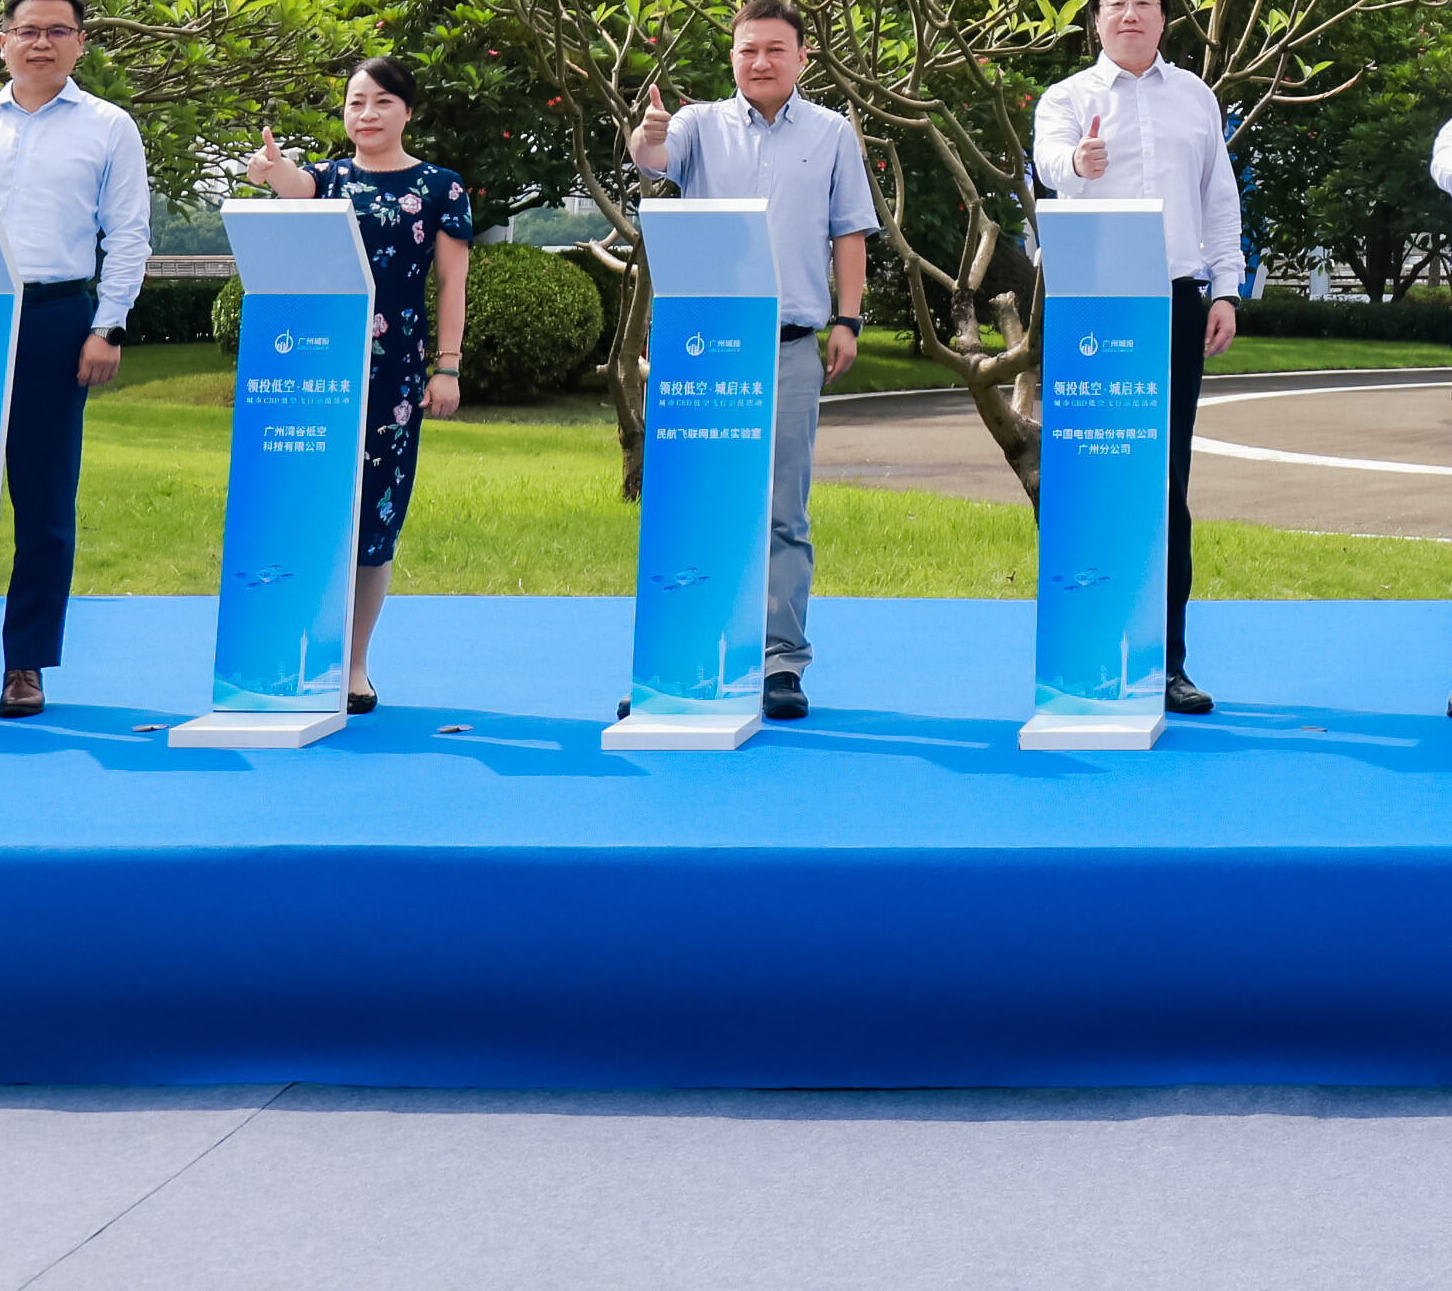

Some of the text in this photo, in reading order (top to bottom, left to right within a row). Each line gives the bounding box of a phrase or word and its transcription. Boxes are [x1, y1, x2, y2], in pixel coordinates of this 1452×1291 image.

[264, 426, 327, 437] 广州湾谷低空
[656, 428, 762, 440] 民航飞联网重点实验室
[1052, 428, 1158, 440] 中国电信股份有限公司
[263, 441, 326, 453] 科技有限公司
[1078, 444, 1131, 455] 广州分公司
